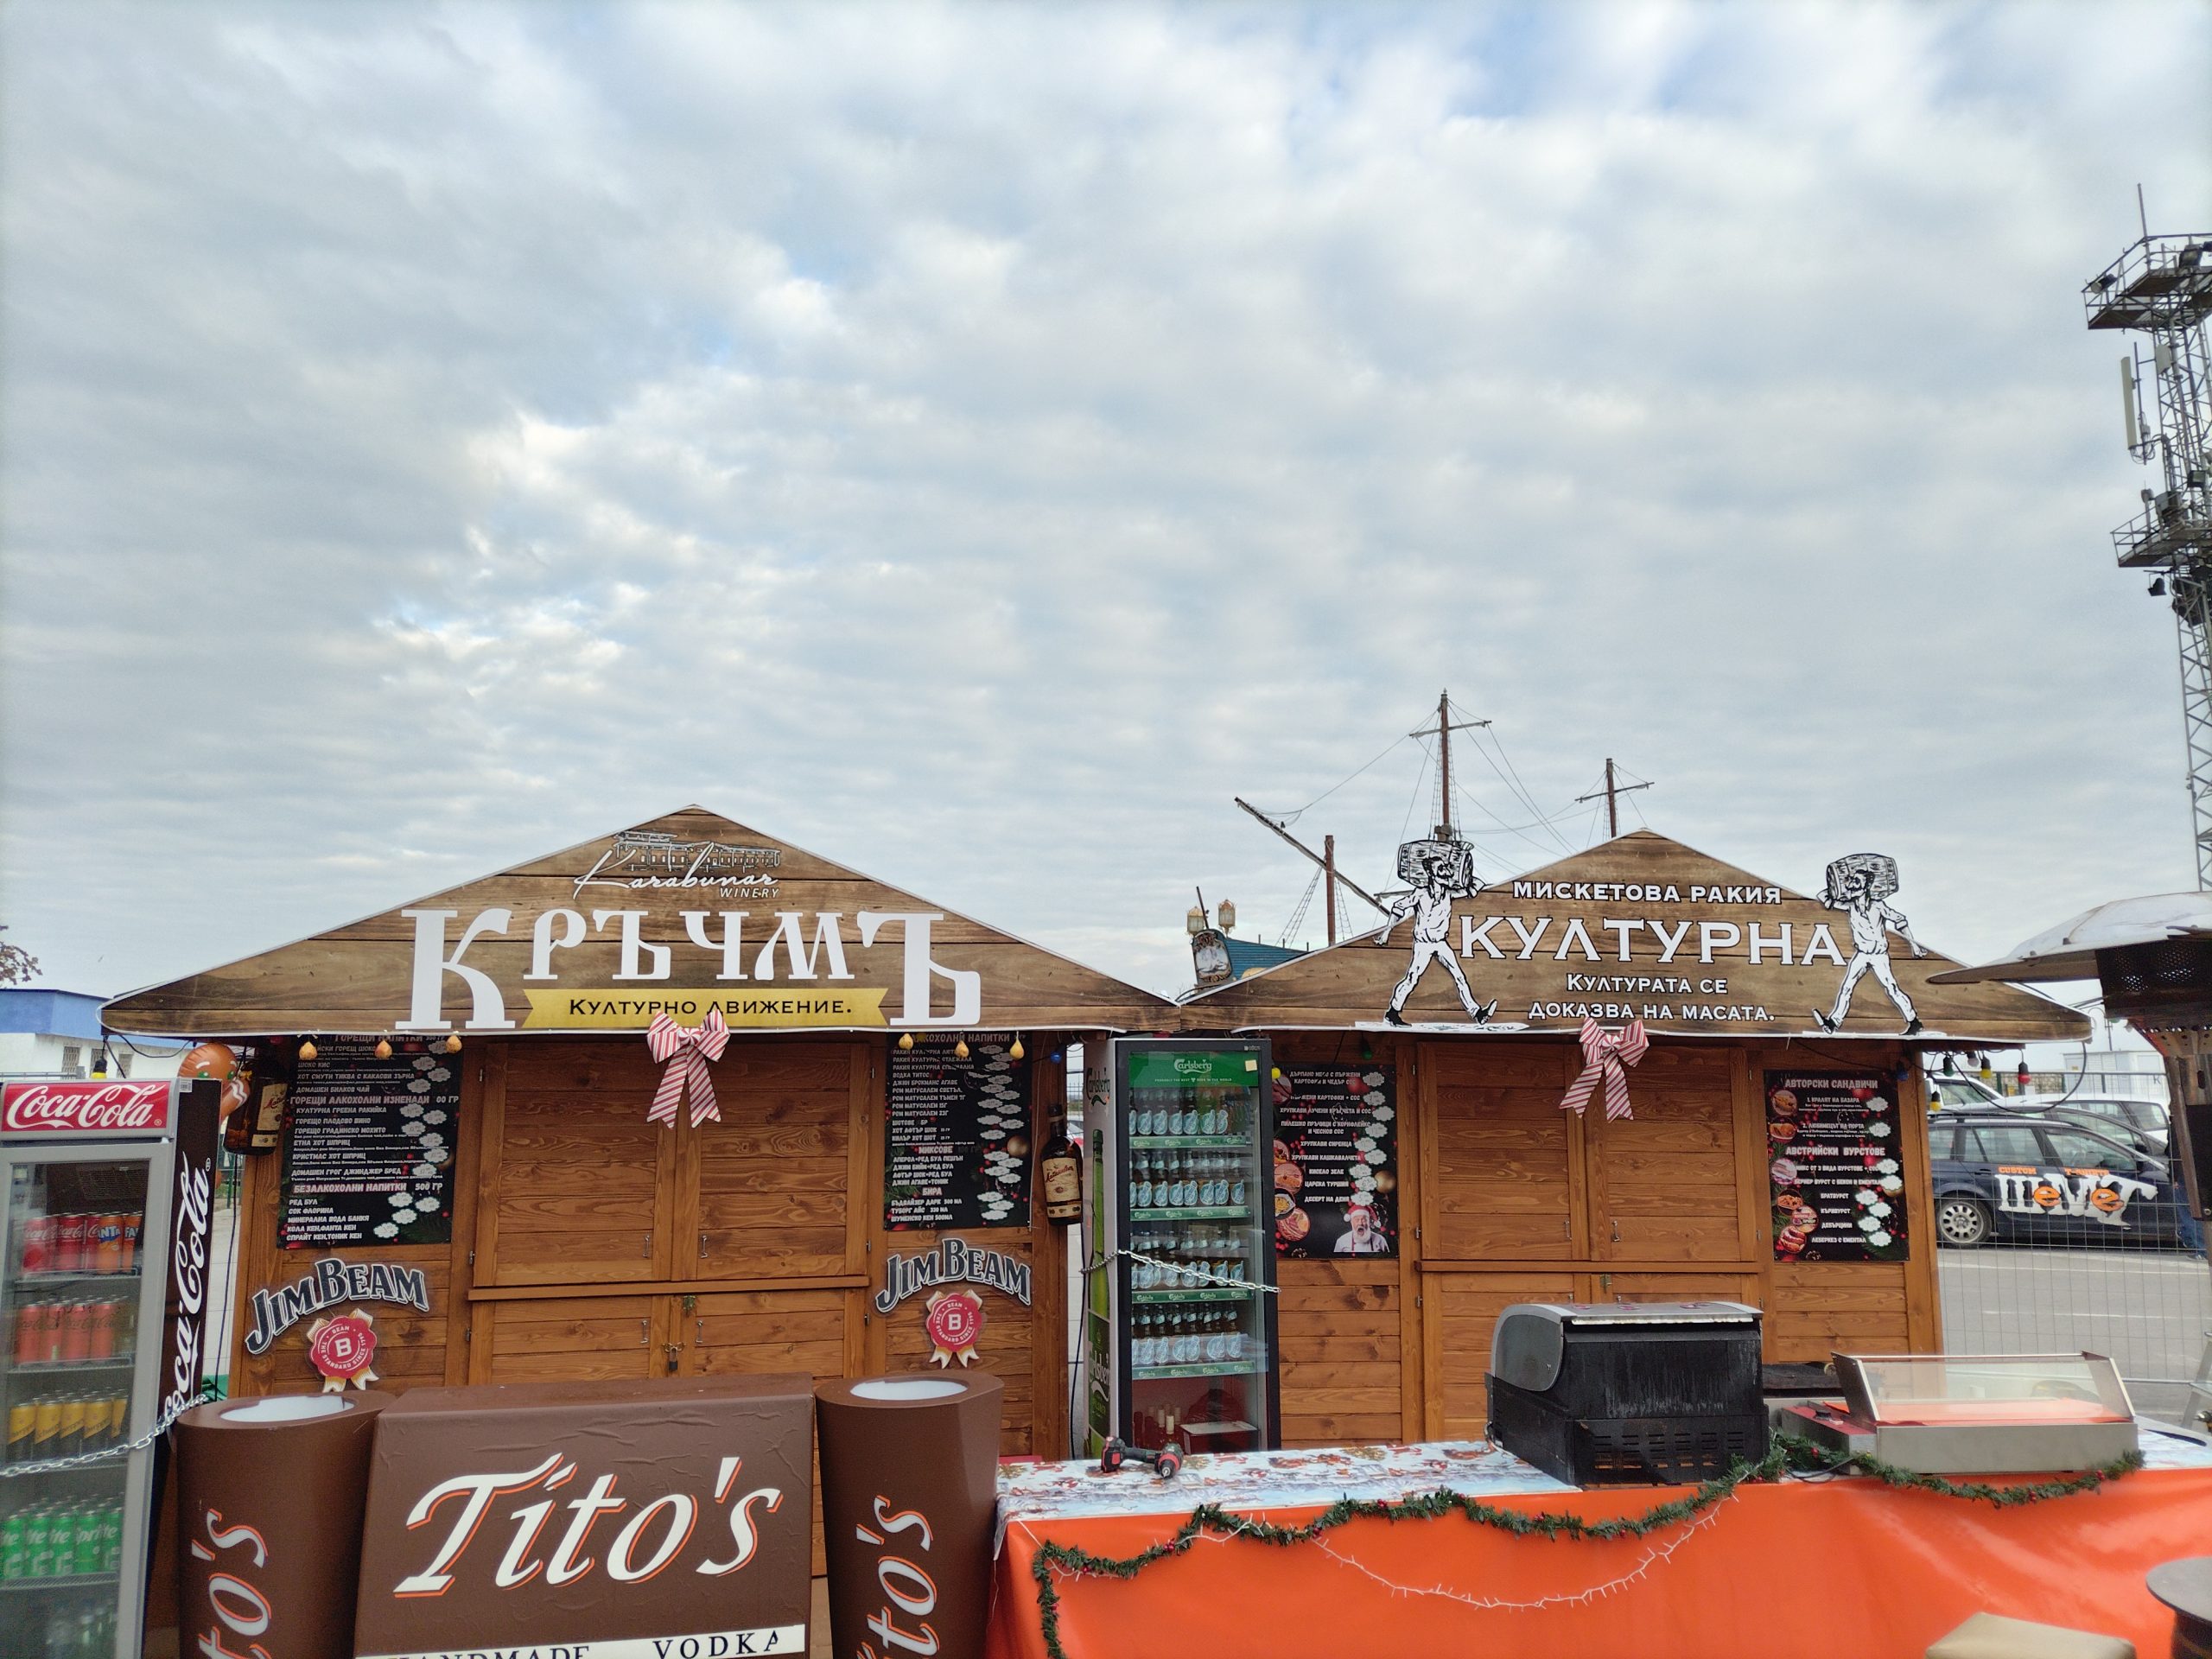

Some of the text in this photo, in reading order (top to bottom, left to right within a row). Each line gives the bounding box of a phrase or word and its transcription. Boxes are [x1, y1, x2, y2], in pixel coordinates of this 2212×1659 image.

[573, 842, 779, 899] Karabunar
[720, 888, 779, 898] WINERY
[1512, 881, 1782, 906] МИСКЕТОВА РАКИЯ
[1459, 915, 1848, 967] КУЛТУРНА
[1700, 976, 1728, 995] СЕ
[1528, 1002, 1775, 1022] ДОКАЗВА НА МАСАТА.
[968, 1033, 1010, 1042] НАПИТКИ
[1174, 1058, 1212, 1074] Carlsberg
[1785, 1079, 1878, 1090] АВТОРСКИ САНДВИЧИ
[6, 1084, 167, 1128] Coca-Cola
[290, 1096, 326, 1105] ГОРЕЩИ
[328, 1096, 381, 1104] АЛКОХОЛНИ
[384, 1096, 429, 1104] ИЗНЕНАДИ
[1786, 1144, 1885, 1156] АВСТРИЙСКИ ВУРСТОВЕ
[1999, 1166, 2037, 1175] CUSTOM
[294, 1184, 364, 1192] БЕЗАЛКОХОЛНИ
[365, 1183, 407, 1192] НАПИТКИ
[922, 1187, 943, 1196] БИРА
[875, 1237, 1031, 1313] JIM BEAM
[245, 1257, 429, 1355] JIM BEAM
[948, 1313, 961, 1331] B
[334, 1338, 352, 1357] B
[393, 1452, 784, 1598] Tito's
[191, 1508, 272, 1659] to's
[855, 1495, 940, 1659] to's
[652, 1630, 779, 1659] VODKA
